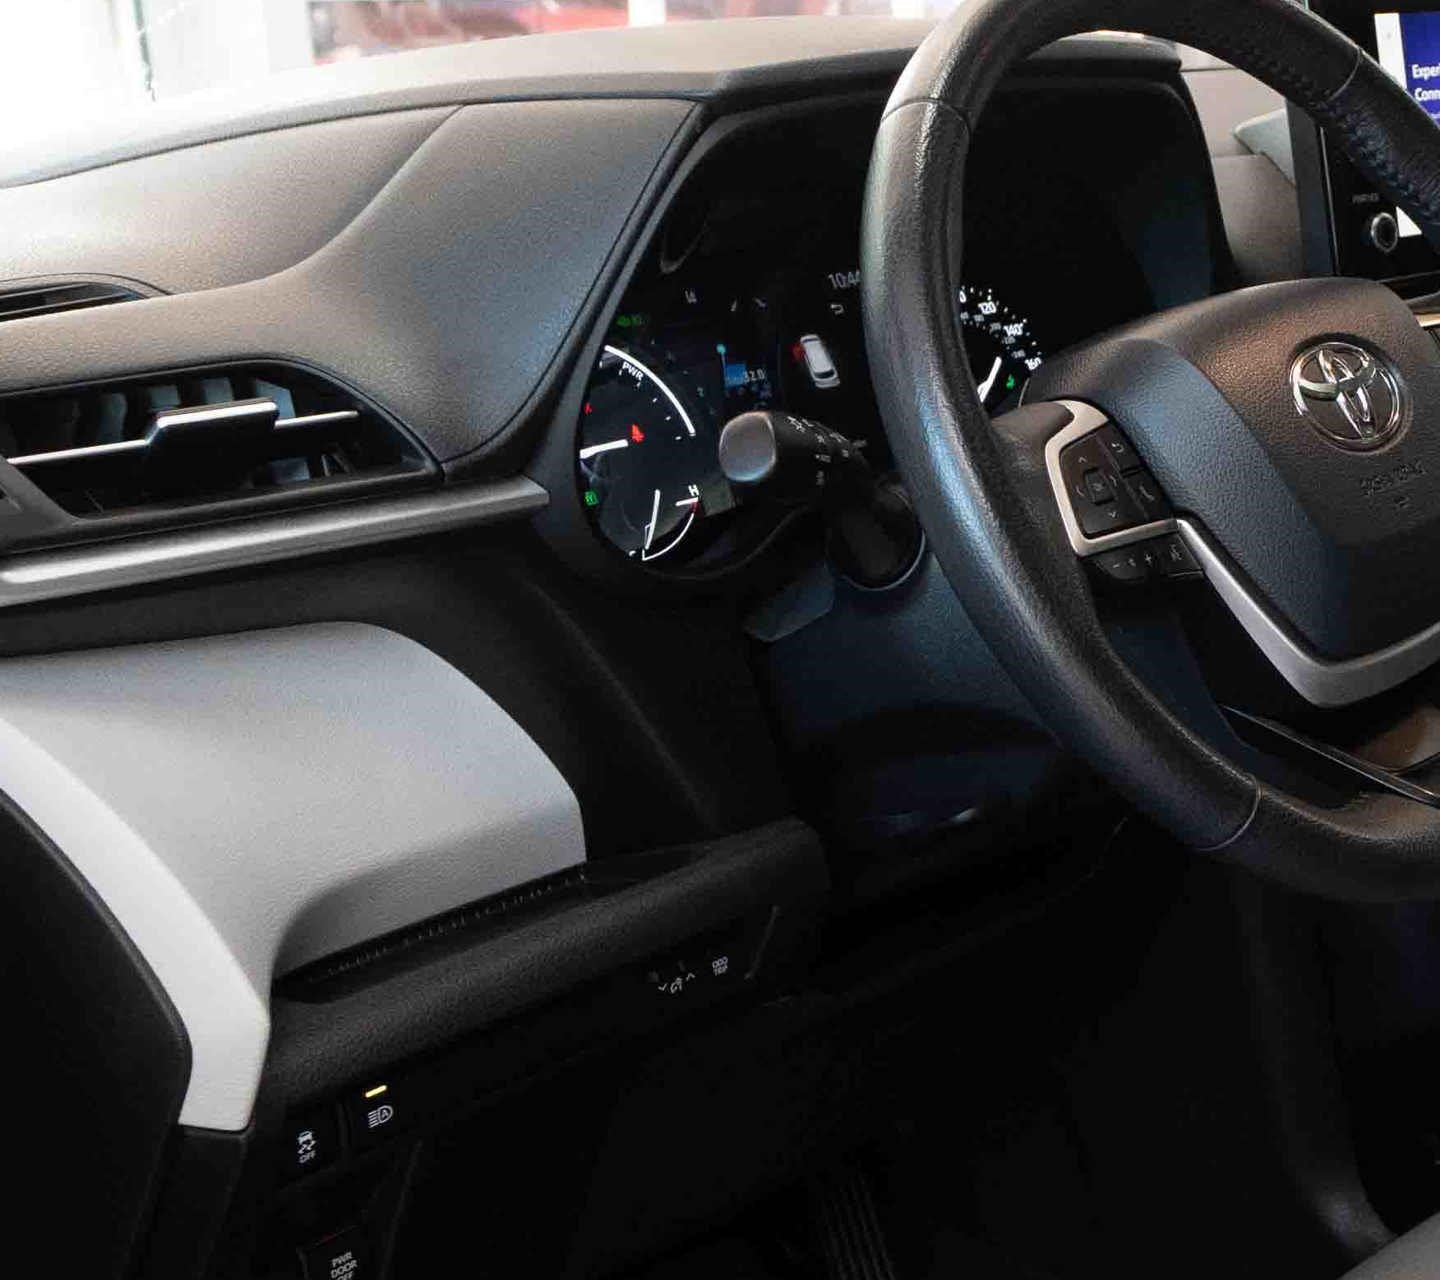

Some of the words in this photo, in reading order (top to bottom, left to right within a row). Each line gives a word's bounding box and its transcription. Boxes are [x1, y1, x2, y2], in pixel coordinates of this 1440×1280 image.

[621, 361, 644, 381] PWR
[688, 484, 700, 497] H
[299, 1150, 316, 1163] OFF
[332, 1251, 353, 1267] PWR
[331, 1260, 358, 1279] DOOR
